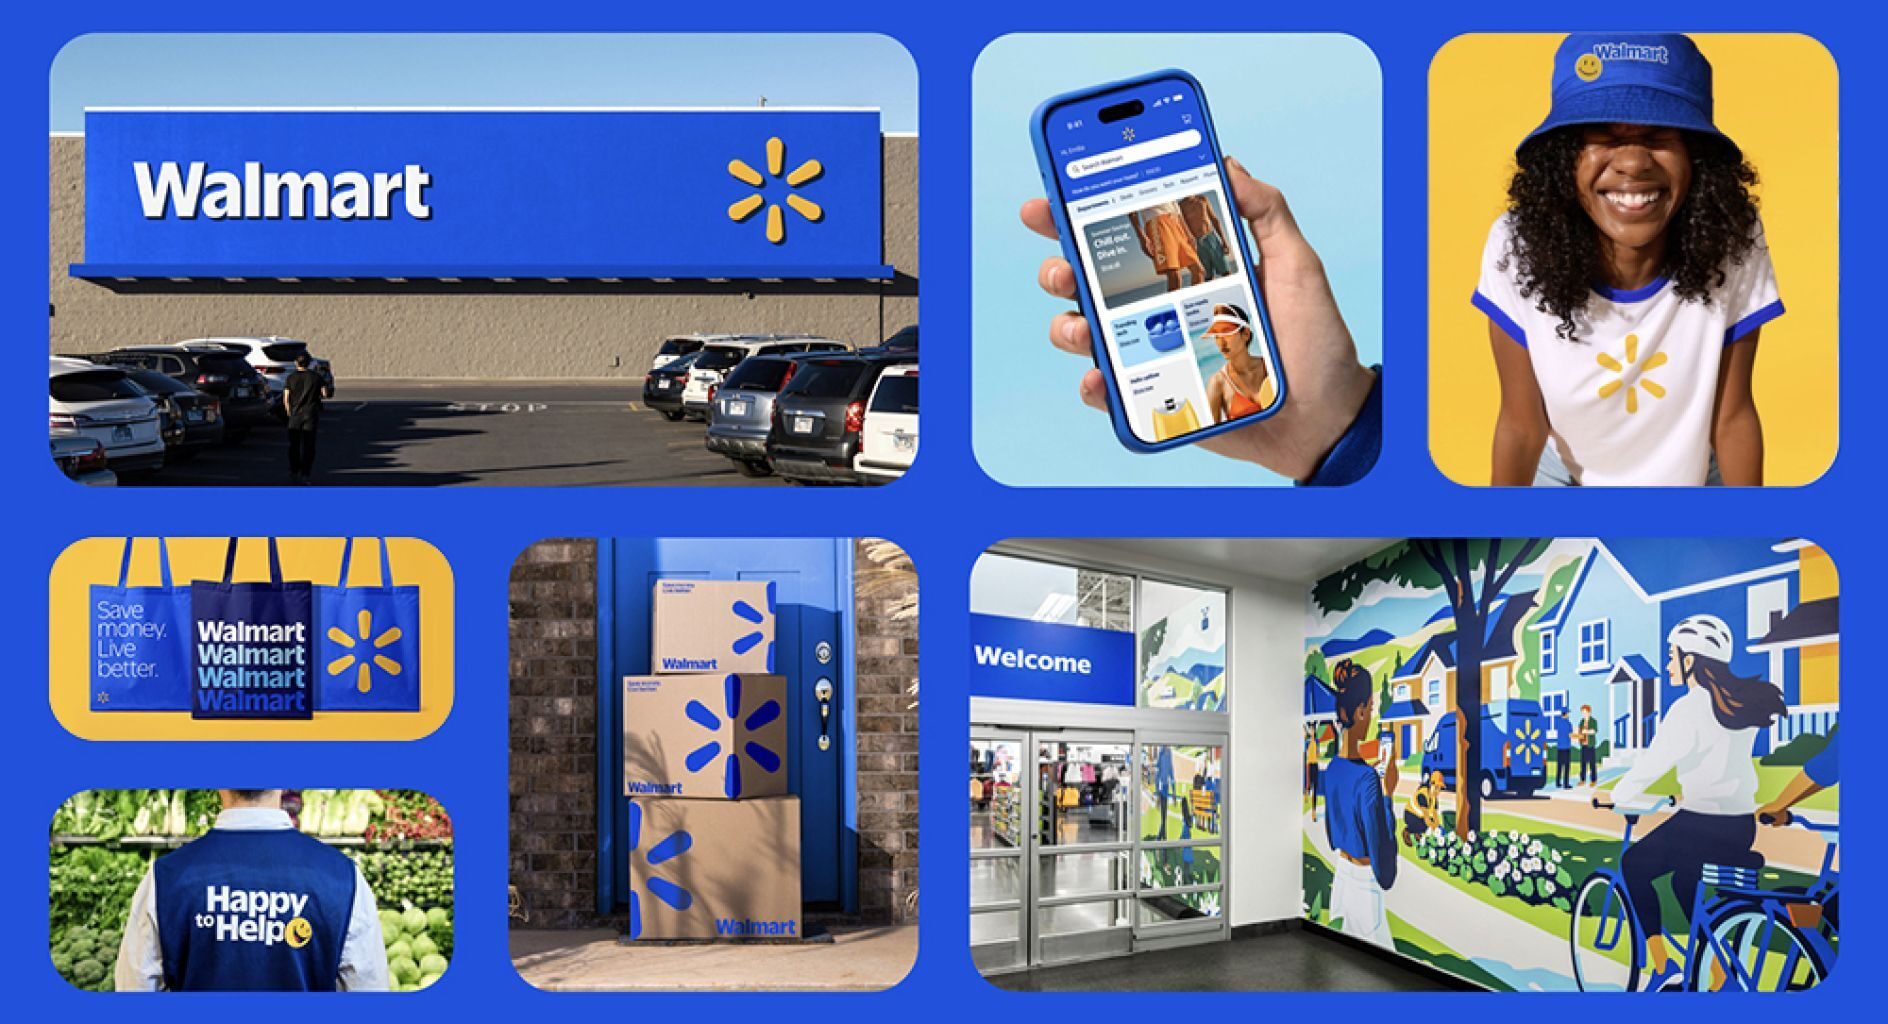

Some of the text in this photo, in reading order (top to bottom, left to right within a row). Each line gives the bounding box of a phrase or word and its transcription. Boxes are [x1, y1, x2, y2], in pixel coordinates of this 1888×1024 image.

[1593, 41, 1669, 65] Walmart
[133, 161, 430, 219] Walmart
[1093, 232, 1131, 249] Chill out.
[1096, 249, 1116, 260] Dive
[446, 402, 548, 413] STOP
[97, 601, 144, 619] Save
[97, 621, 167, 640] money.
[198, 620, 305, 642] Walmart
[97, 639, 137, 658] Live
[198, 643, 305, 666] Walmart
[97, 659, 159, 678] better.
[662, 657, 718, 670] Walmart
[974, 644, 1092, 674] Welcome
[198, 667, 305, 689] Walmart
[198, 689, 305, 712] Walmart
[628, 781, 683, 795] Walmart
[206, 885, 309, 918] Happy
[195, 912, 286, 945] to Help
[715, 919, 796, 935] Walmart
